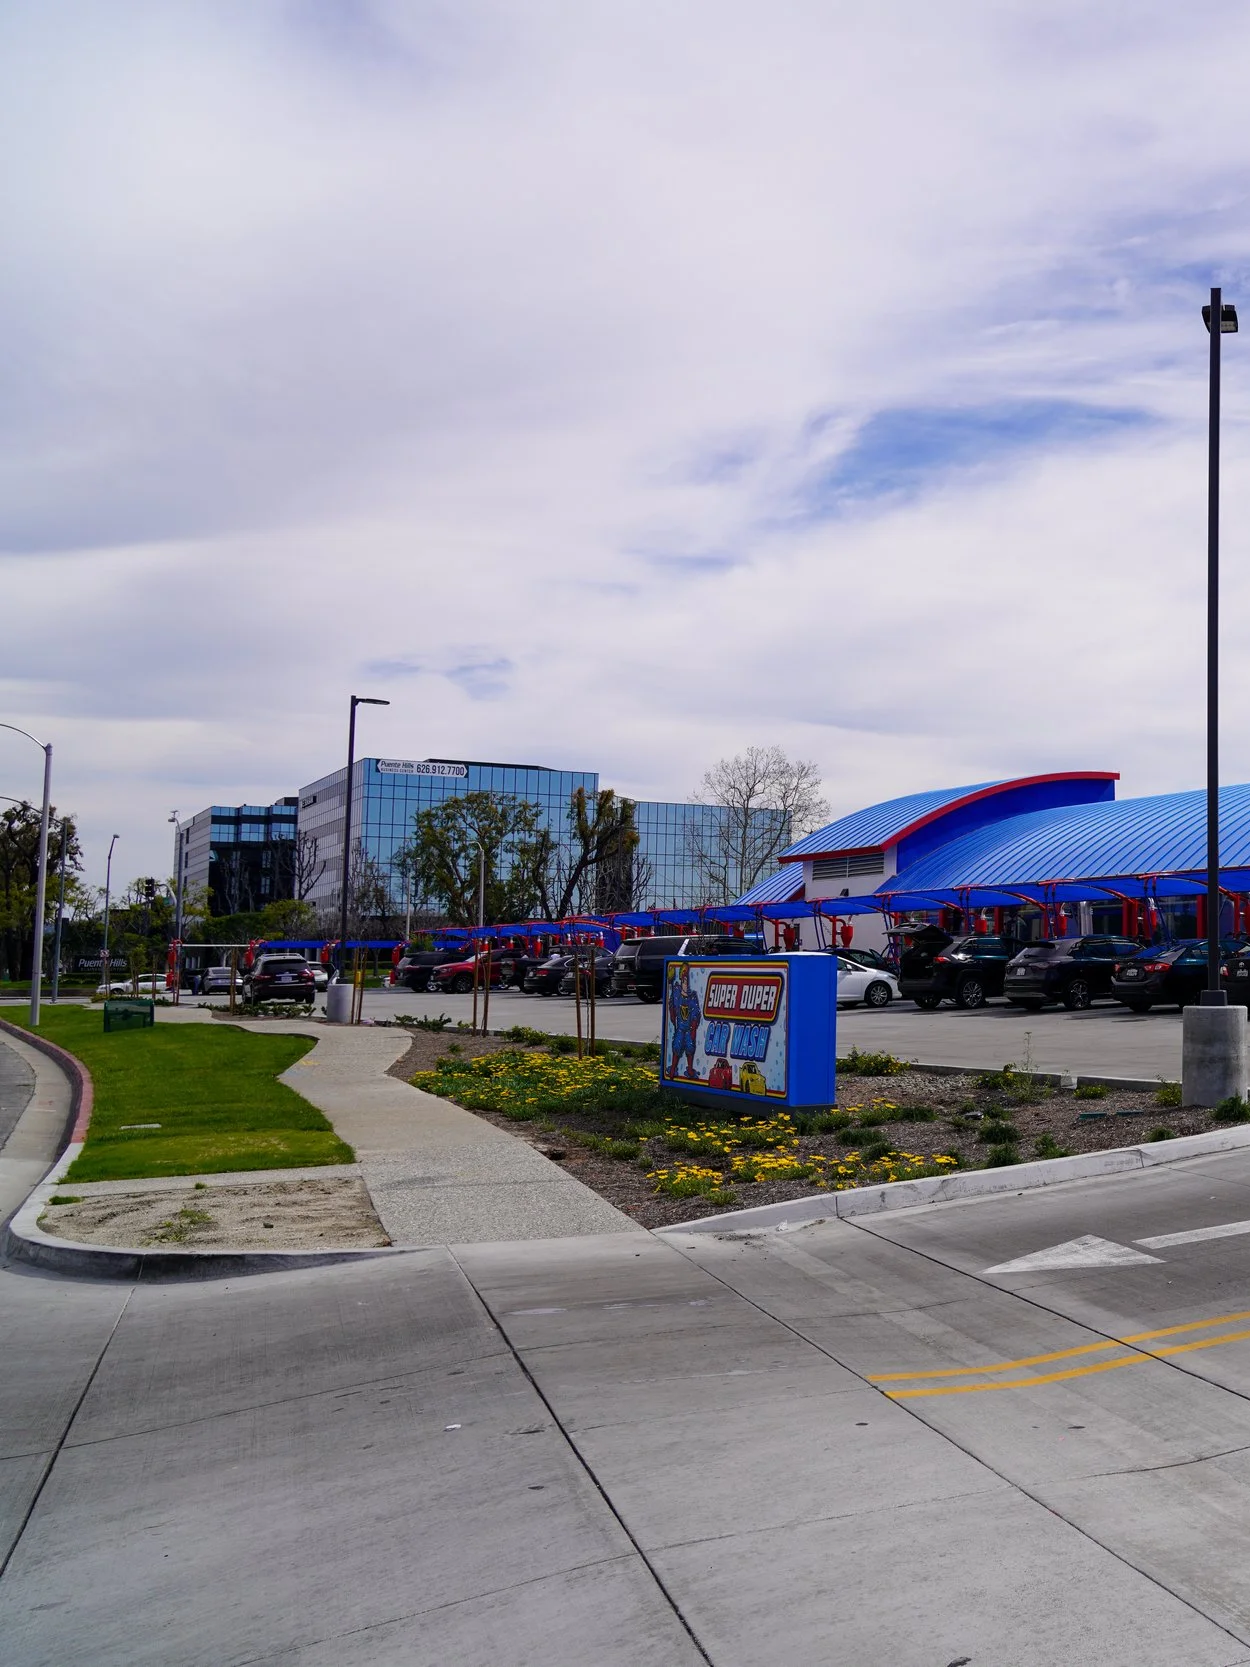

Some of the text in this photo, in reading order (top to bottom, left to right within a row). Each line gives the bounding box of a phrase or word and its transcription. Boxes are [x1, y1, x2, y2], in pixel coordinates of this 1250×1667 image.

[402, 761, 415, 769] Hills
[416, 764, 465, 776] 626.912.7700
[78, 958, 128, 968] Puent Hills
[708, 984, 778, 1012] SUPER DUPER
[705, 1021, 770, 1059] CAR WASH
